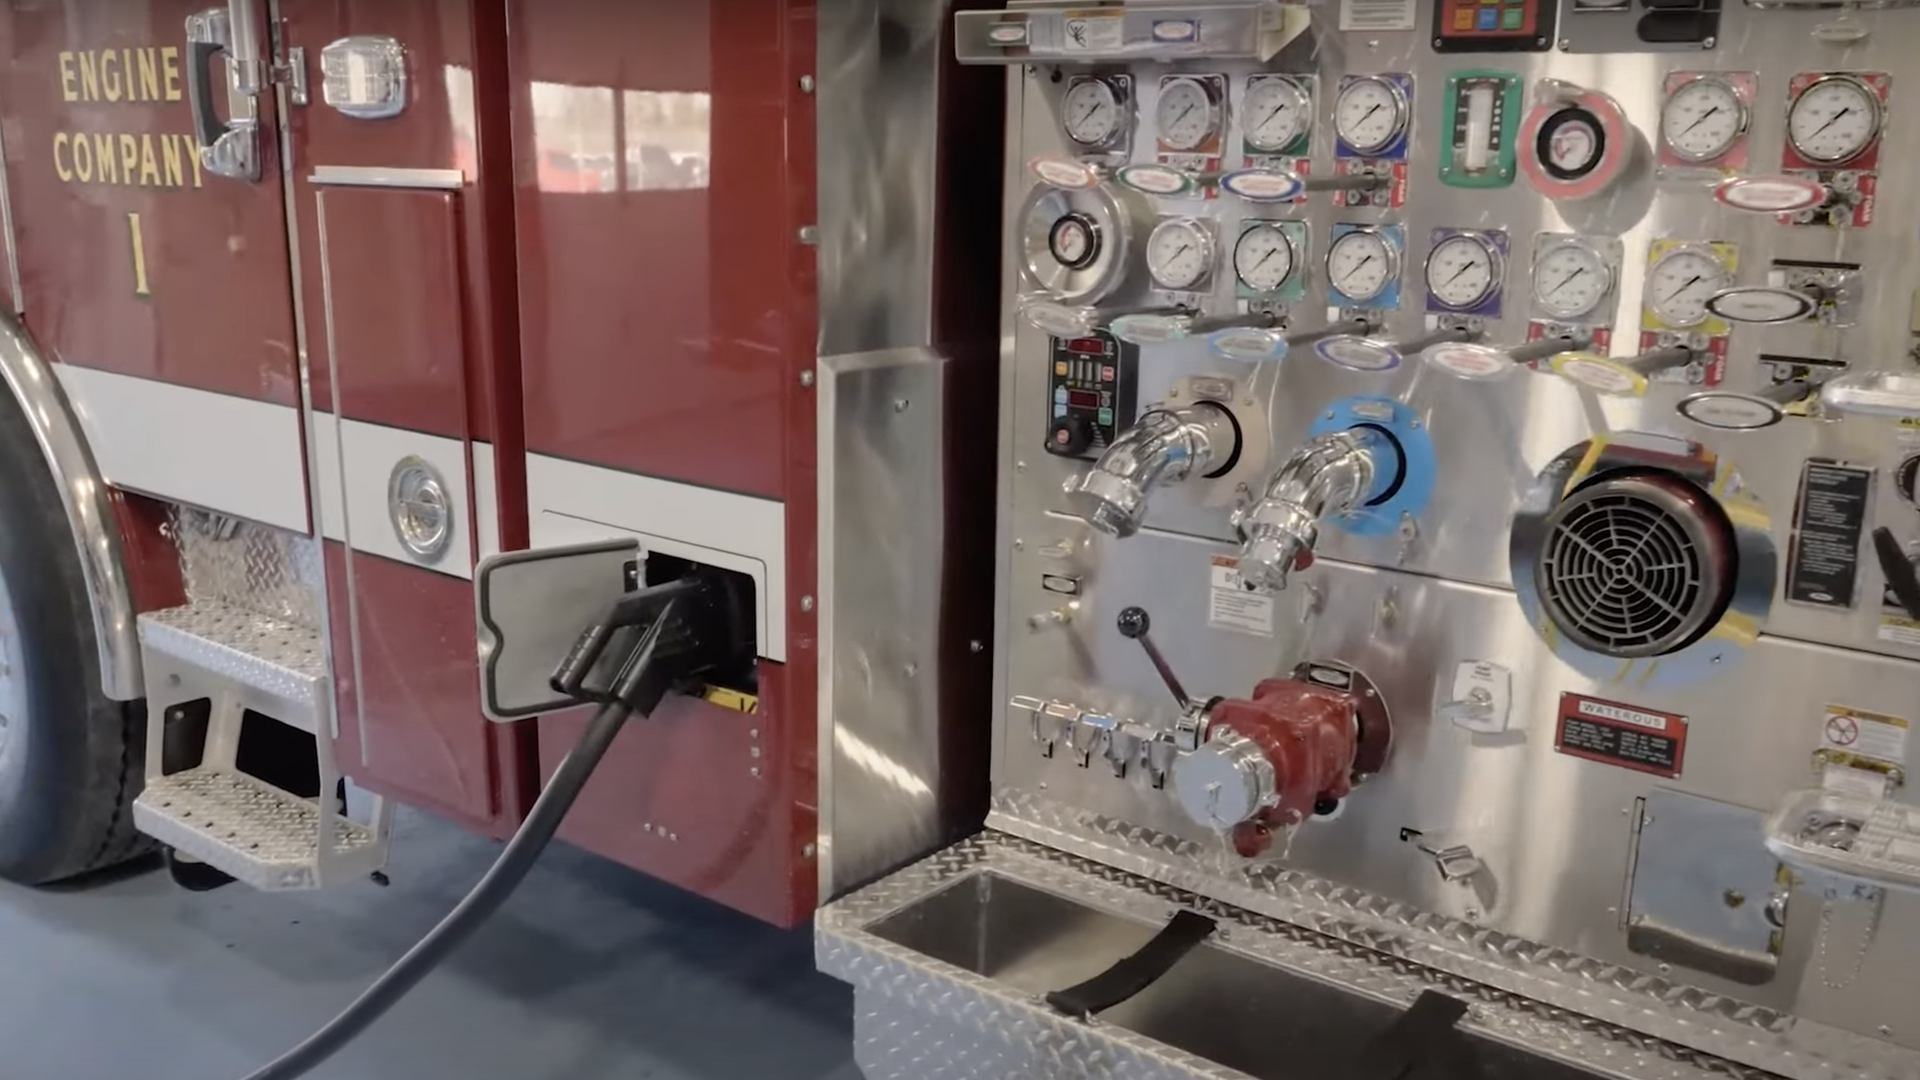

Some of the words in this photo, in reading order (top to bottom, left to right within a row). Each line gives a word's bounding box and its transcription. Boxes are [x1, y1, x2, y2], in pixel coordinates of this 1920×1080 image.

[59, 46, 181, 102] ENGINE
[53, 132, 202, 188] COMPANY
[1582, 702, 1663, 727] WATEROUS
